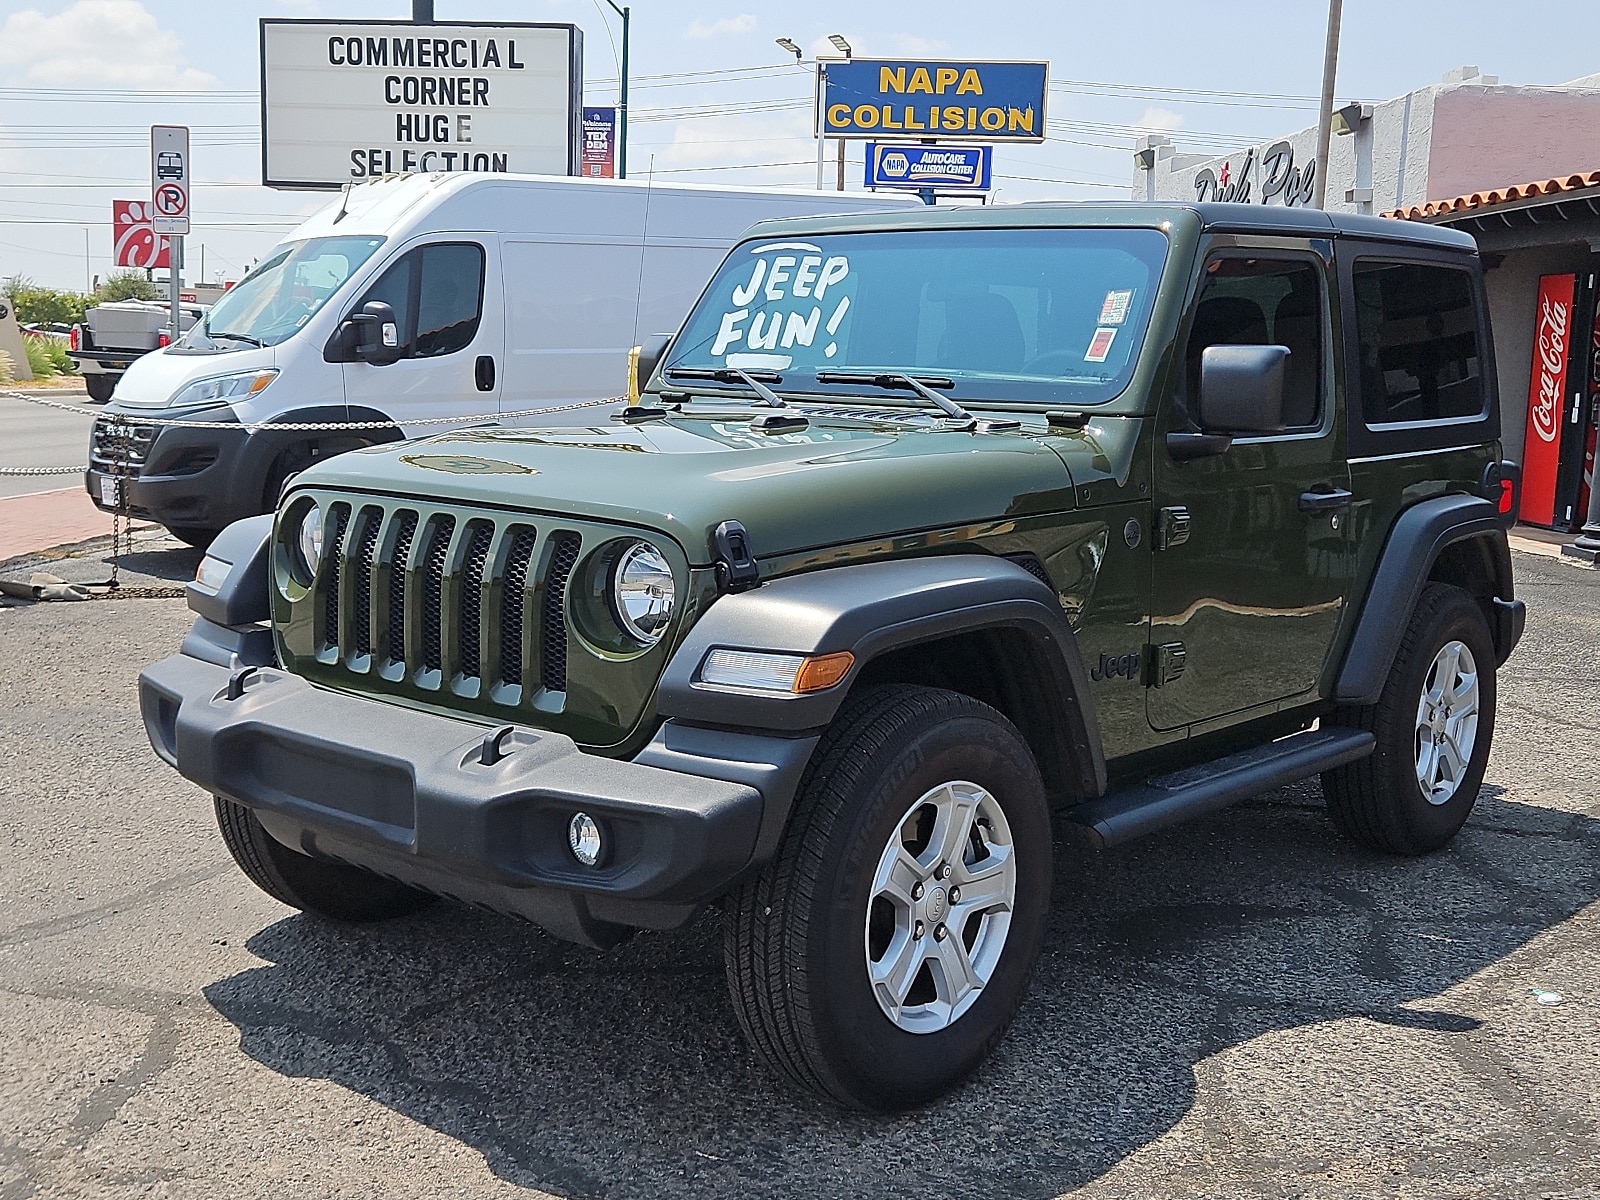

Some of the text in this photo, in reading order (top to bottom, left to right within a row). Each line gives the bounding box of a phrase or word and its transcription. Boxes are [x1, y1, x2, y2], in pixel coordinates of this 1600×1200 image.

[328, 36, 525, 69] COMMERCIAL
[384, 75, 490, 106] CORNER
[879, 66, 983, 95] NAPA
[396, 113, 472, 143] HUGE
[826, 104, 1034, 132] COLLISION
[586, 131, 608, 140] TEX
[586, 141, 608, 149] DEM
[350, 149, 508, 177] SELECTION
[886, 159, 905, 171] NAPA
[732, 255, 850, 307] JEEP
[710, 295, 851, 358] FUN!
[1091, 652, 1141, 682] Jeep
